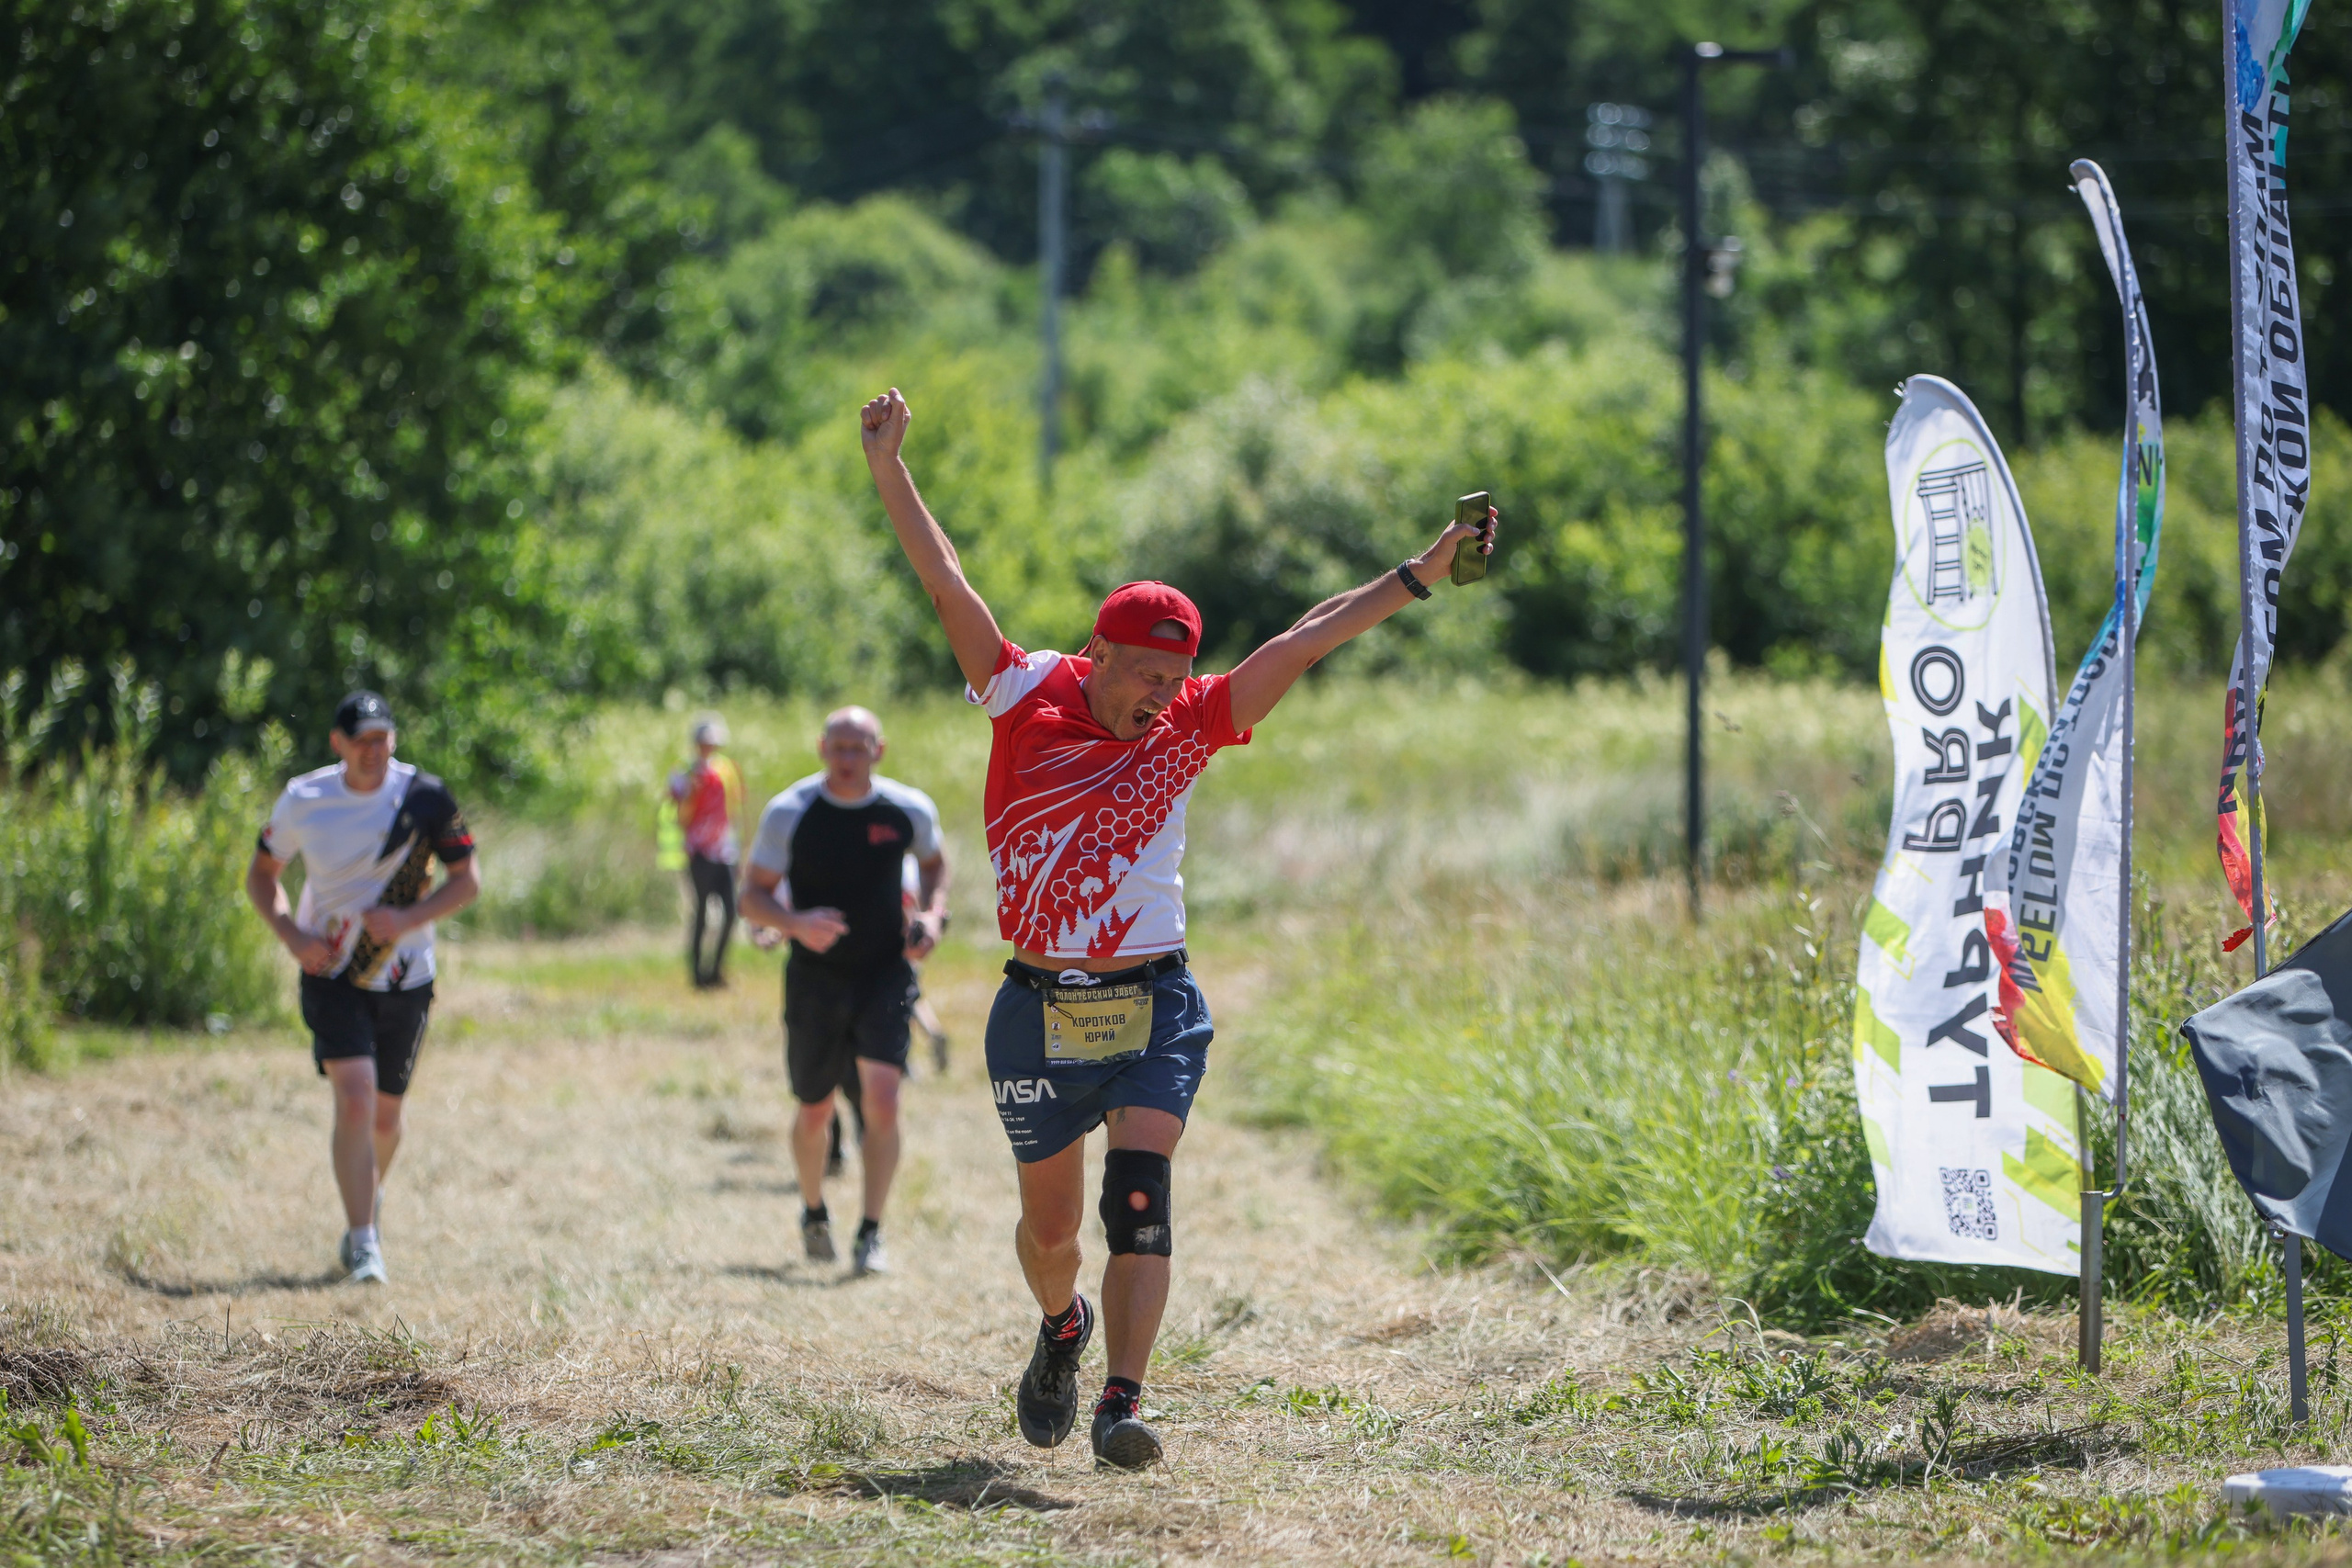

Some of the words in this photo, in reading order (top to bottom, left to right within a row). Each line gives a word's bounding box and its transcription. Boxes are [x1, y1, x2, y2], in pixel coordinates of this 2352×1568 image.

[1114, 985, 1138, 998] ЗАБЕГ
[1072, 1013, 1126, 1028] КОРОТКОВ
[1085, 1028, 1115, 1043] ЮРИЙ
